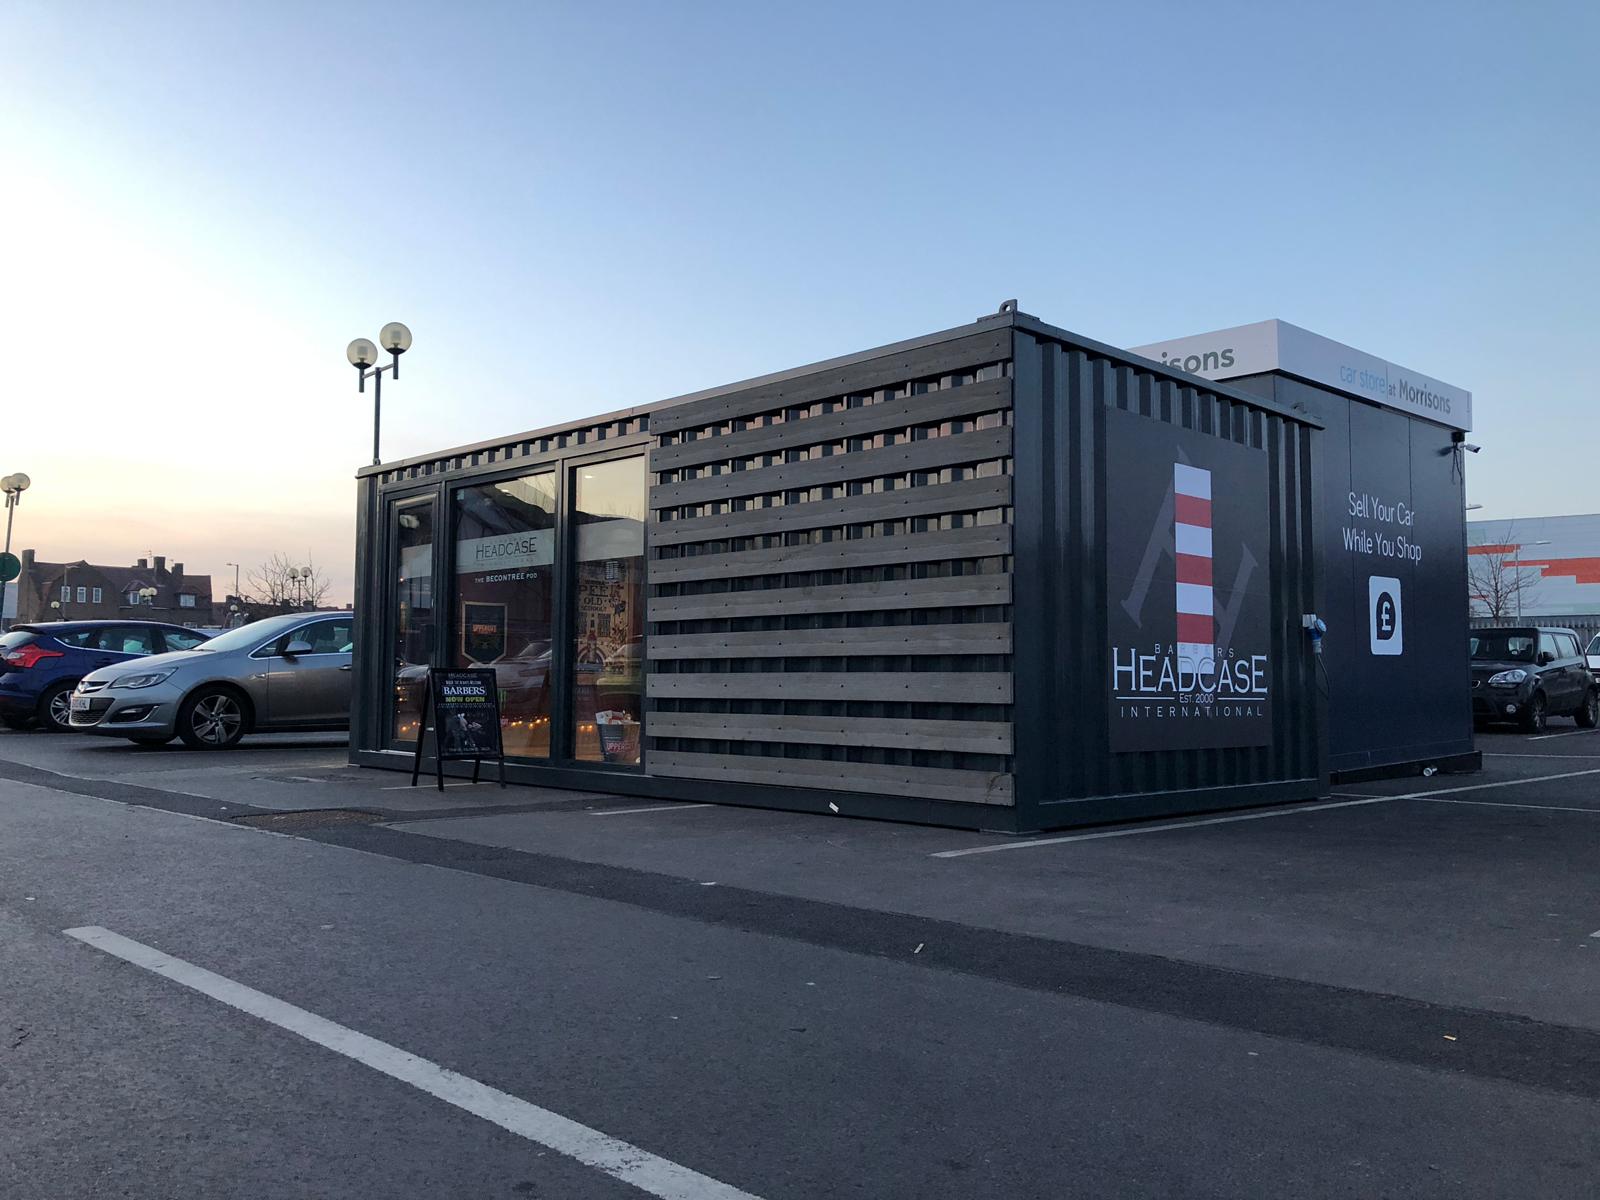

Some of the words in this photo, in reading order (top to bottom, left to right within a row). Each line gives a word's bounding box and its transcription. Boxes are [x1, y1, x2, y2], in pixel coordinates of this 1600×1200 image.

[1338, 365, 1357, 384] car
[1359, 369, 1386, 393] store
[1388, 382, 1397, 397] at
[1399, 378, 1452, 414] Morrisons
[1348, 492, 1370, 519] Sell
[1371, 496, 1395, 523] Your
[1397, 502, 1415, 526] Car
[475, 536, 537, 560] HEADCASE
[1342, 527, 1373, 555] While
[1374, 532, 1395, 557] You
[1396, 536, 1422, 567] Shop
[485, 572, 525, 583] BECONTREE
[1112, 647, 1268, 694] HEADCASE
[443, 686, 486, 695] BARBERS
[1195, 693, 1214, 704] 2000
[1121, 705, 1263, 718] INTERNATIONAL
